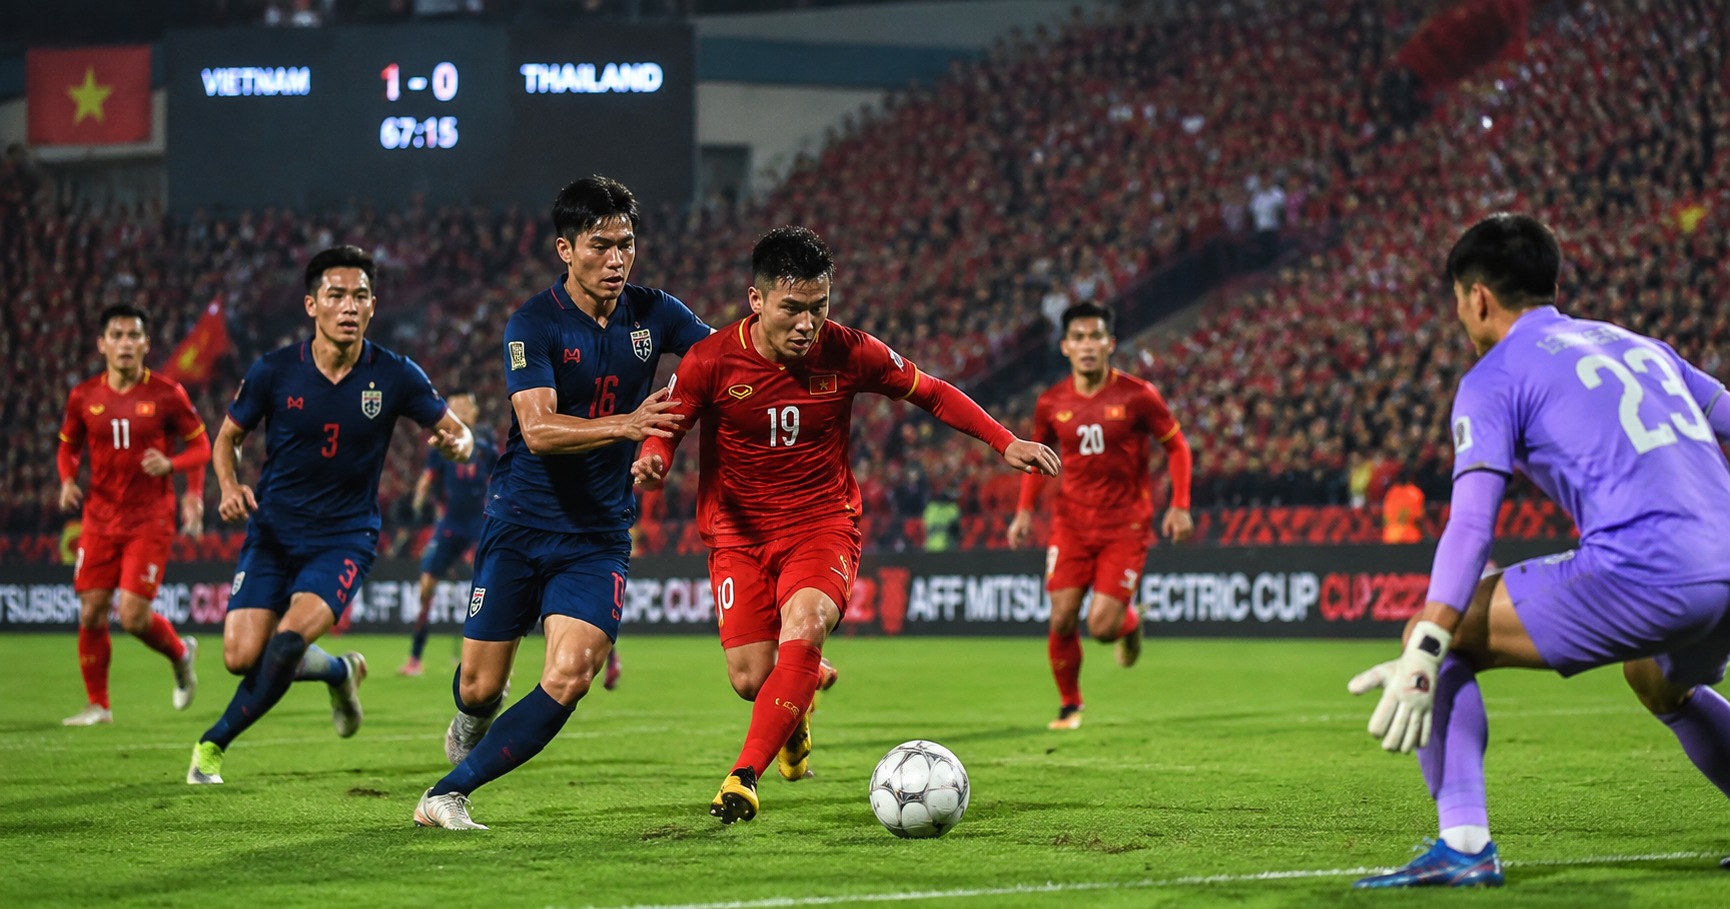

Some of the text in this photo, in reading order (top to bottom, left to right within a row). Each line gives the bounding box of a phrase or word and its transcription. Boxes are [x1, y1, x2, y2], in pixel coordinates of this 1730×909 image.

[201, 66, 311, 97] VIETNAM
[520, 62, 664, 94] THAILAND
[380, 116, 459, 149] 67:15
[588, 375, 619, 418] 16
[1576, 347, 1713, 455] 23
[111, 418, 130, 449] 11
[321, 423, 339, 458] 3
[757, 405, 800, 447] 19
[1076, 423, 1105, 456] 20
[908, 575, 963, 622] AFF
[1252, 571, 1319, 622] CUP
